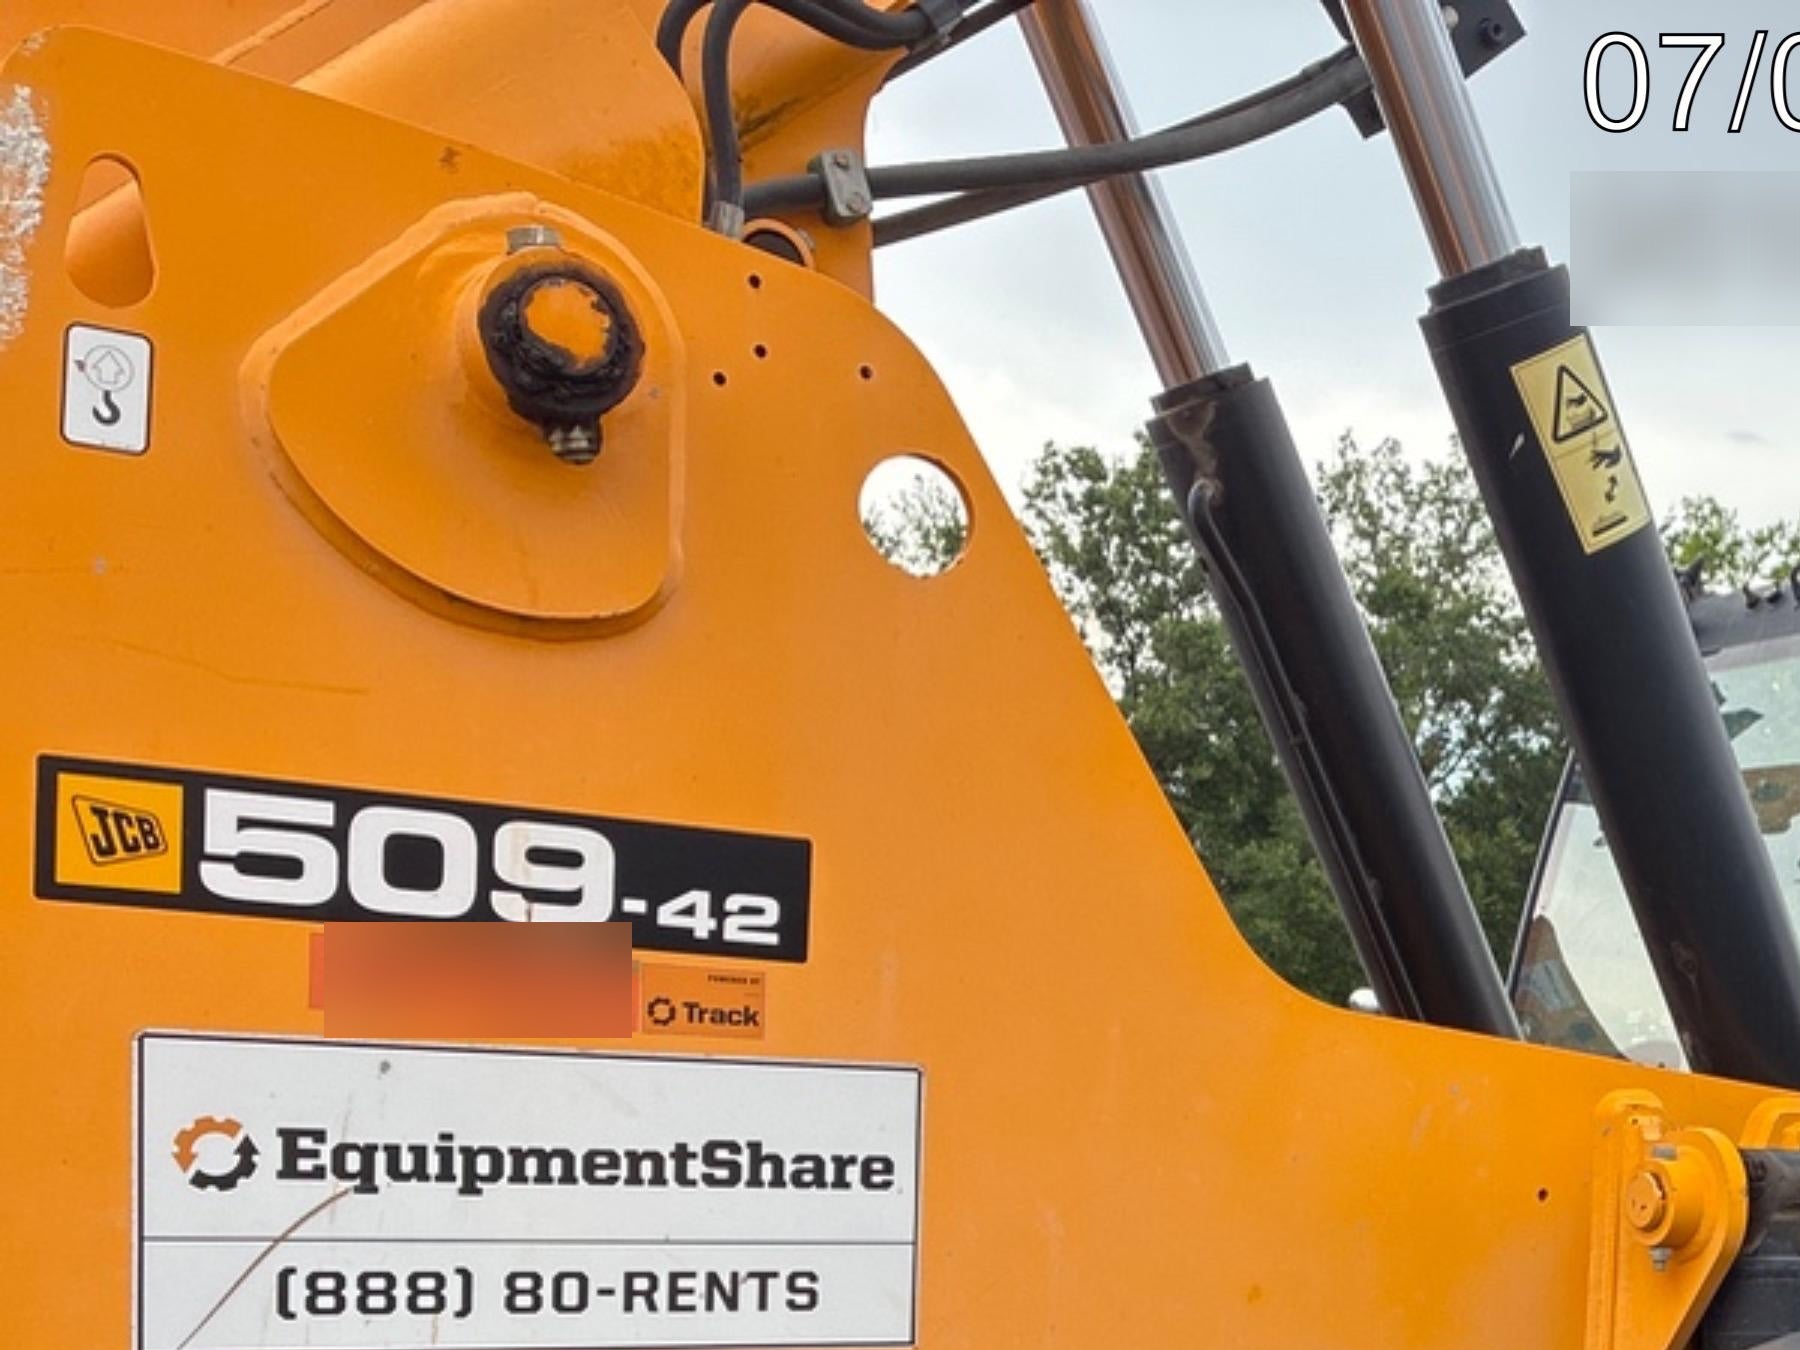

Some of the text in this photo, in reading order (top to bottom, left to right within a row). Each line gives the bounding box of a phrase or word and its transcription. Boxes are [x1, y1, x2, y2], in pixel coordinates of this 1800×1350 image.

[90, 805, 161, 857] JCB
[682, 1001, 760, 1027] Track
[275, 1126, 896, 1196] EquipmentShare
[275, 1267, 820, 1318] (888) 80-RENTS
